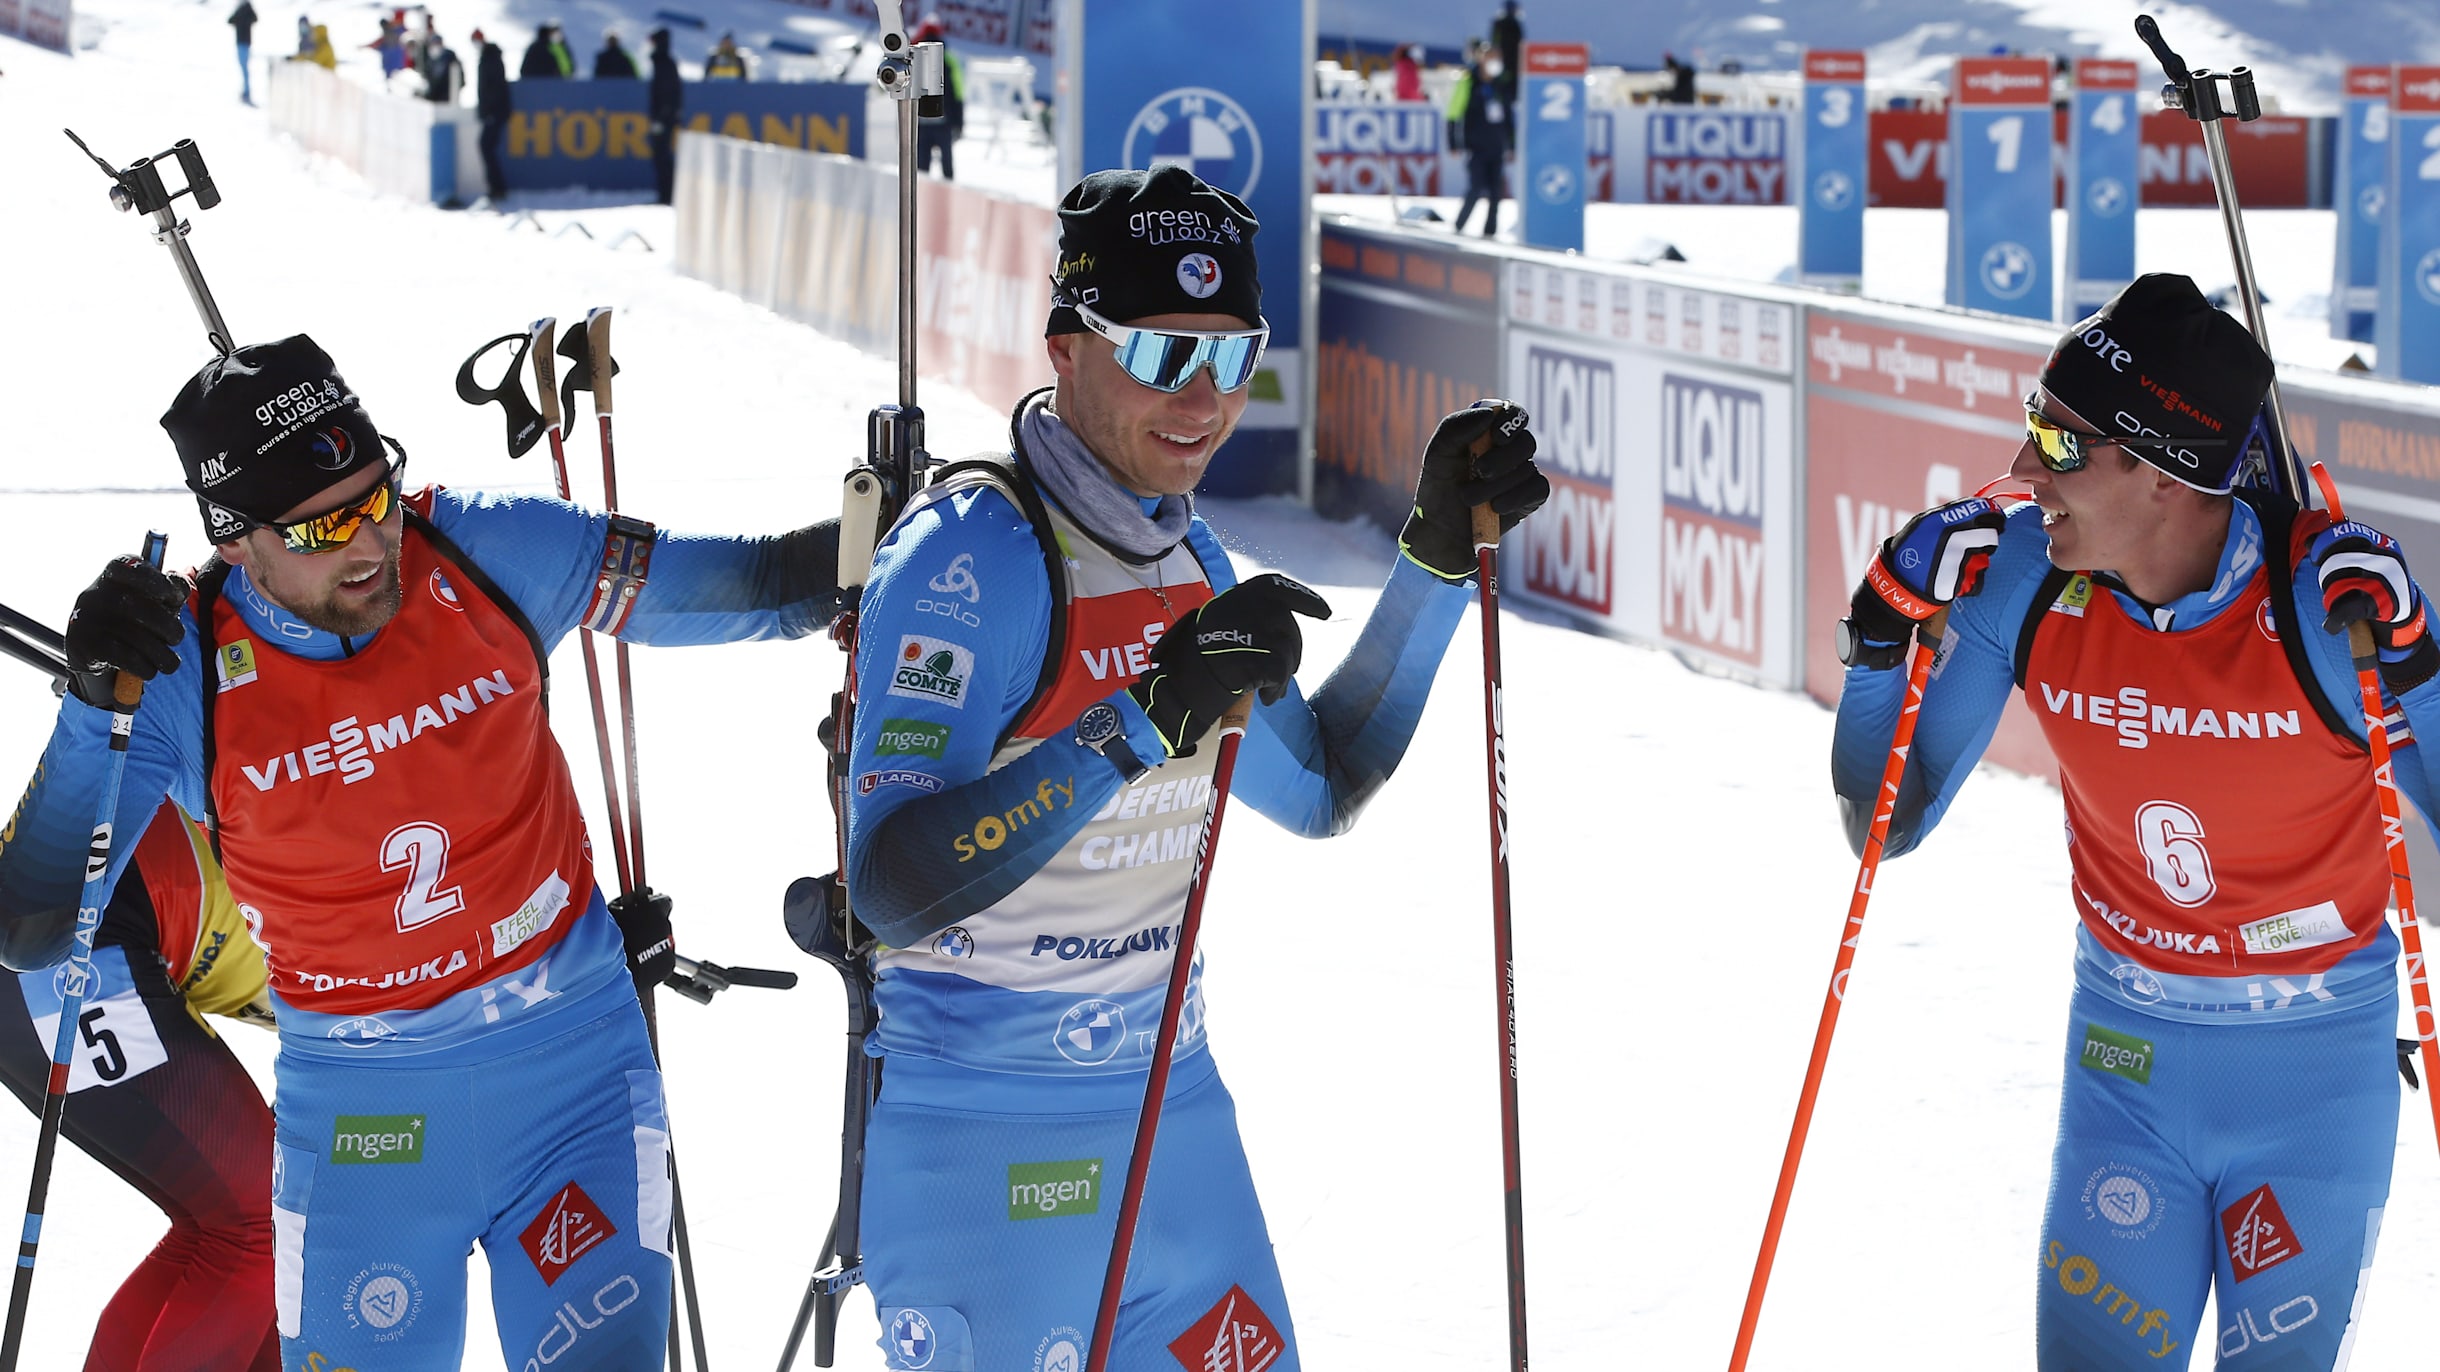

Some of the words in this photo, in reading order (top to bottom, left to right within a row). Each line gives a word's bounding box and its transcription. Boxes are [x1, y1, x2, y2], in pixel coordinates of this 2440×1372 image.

[1540, 82, 1574, 121] 2
[1818, 88, 1852, 127] 3
[2090, 97, 2126, 134] 4
[1653, 115, 1781, 157] LIQUI
[1986, 116, 2023, 173] 1
[1653, 160, 1783, 201] MOLY
[1129, 210, 1211, 238] green
[256, 382, 315, 426] green
[276, 392, 329, 426] weez
[1529, 353, 1612, 479] LIQUI
[2140, 375, 2222, 432] VIESSMANN
[257, 430, 290, 455] courses
[291, 421, 303, 431] en
[302, 409, 325, 423] ligne
[1664, 384, 1761, 517] LIQUI
[200, 458, 226, 483] AIN
[1663, 517, 1762, 652] MOLY
[915, 599, 980, 628] odlo
[896, 670, 961, 697] COMTÉ
[241, 670, 514, 792] VIESSMANN
[2040, 681, 2301, 750] VIESSMANN
[878, 731, 940, 750] mgen
[880, 773, 936, 791] LAPUA
[953, 775, 1075, 863] somfy
[2134, 799, 2217, 909] 6
[379, 820, 466, 933] 2
[497, 926, 504, 937] I
[508, 902, 539, 932] FEEL
[2245, 926, 2254, 942] I
[2256, 915, 2295, 938] FEEL
[78, 1007, 128, 1081] 5
[2084, 1036, 2147, 1070] mgen
[335, 1128, 414, 1159] mgen
[1011, 1176, 1091, 1212] mgen
[343, 1269, 369, 1310] Région
[2043, 1239, 2179, 1360] somfy
[348, 1314, 360, 1329] La
[2213, 1294, 2319, 1364] dlo
